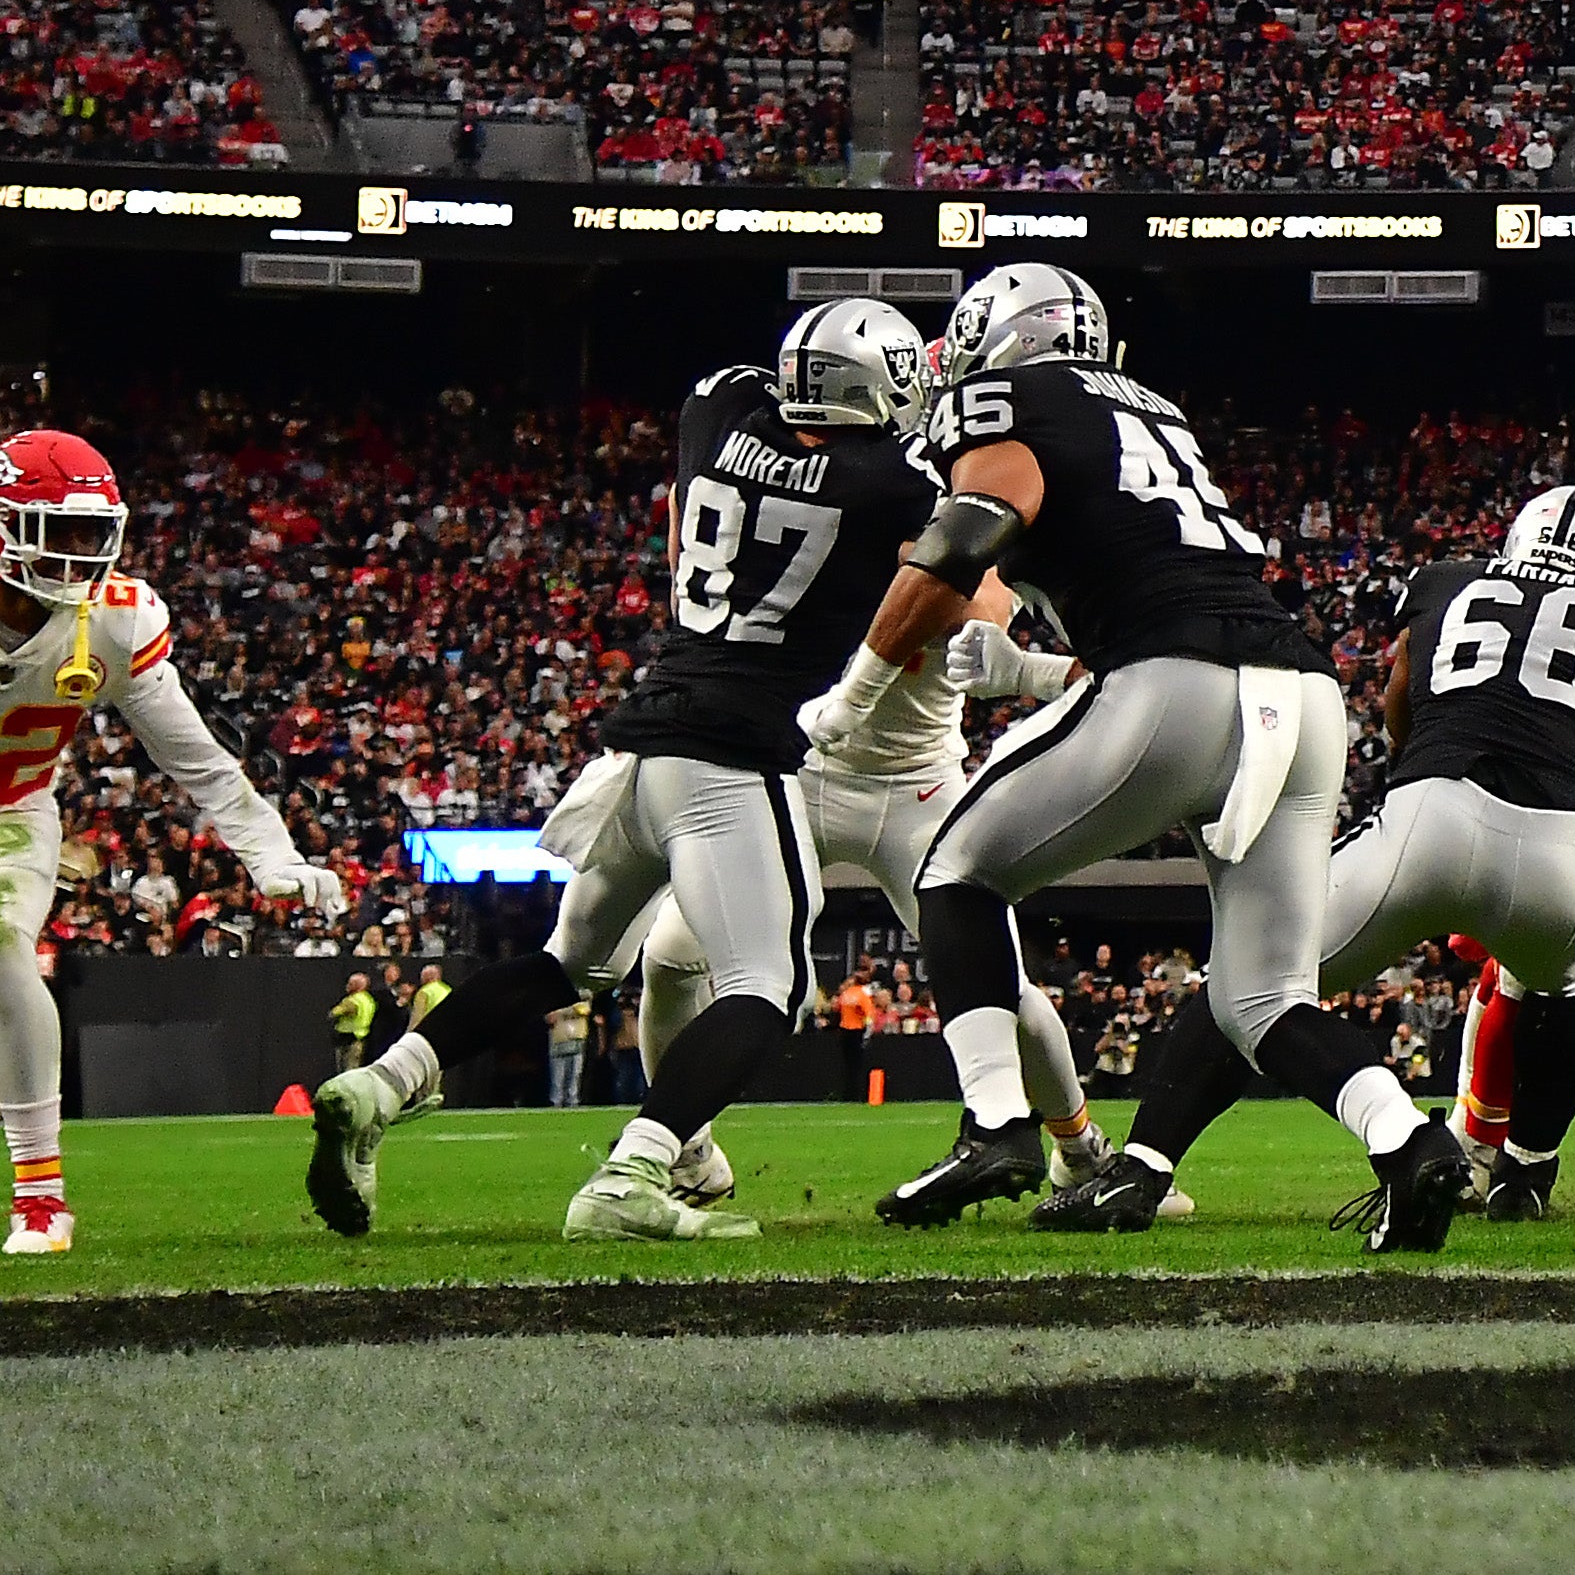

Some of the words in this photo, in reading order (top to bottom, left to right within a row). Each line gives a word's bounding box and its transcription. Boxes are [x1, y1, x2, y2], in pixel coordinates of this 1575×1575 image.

[89, 189, 126, 212] OF
[572, 207, 617, 229] THE
[682, 209, 715, 231] OF
[1146, 217, 1190, 238] THE
[1251, 217, 1282, 238] OF
[927, 380, 1014, 452] 45
[715, 430, 830, 494] MOREAU
[677, 474, 844, 645] 87
